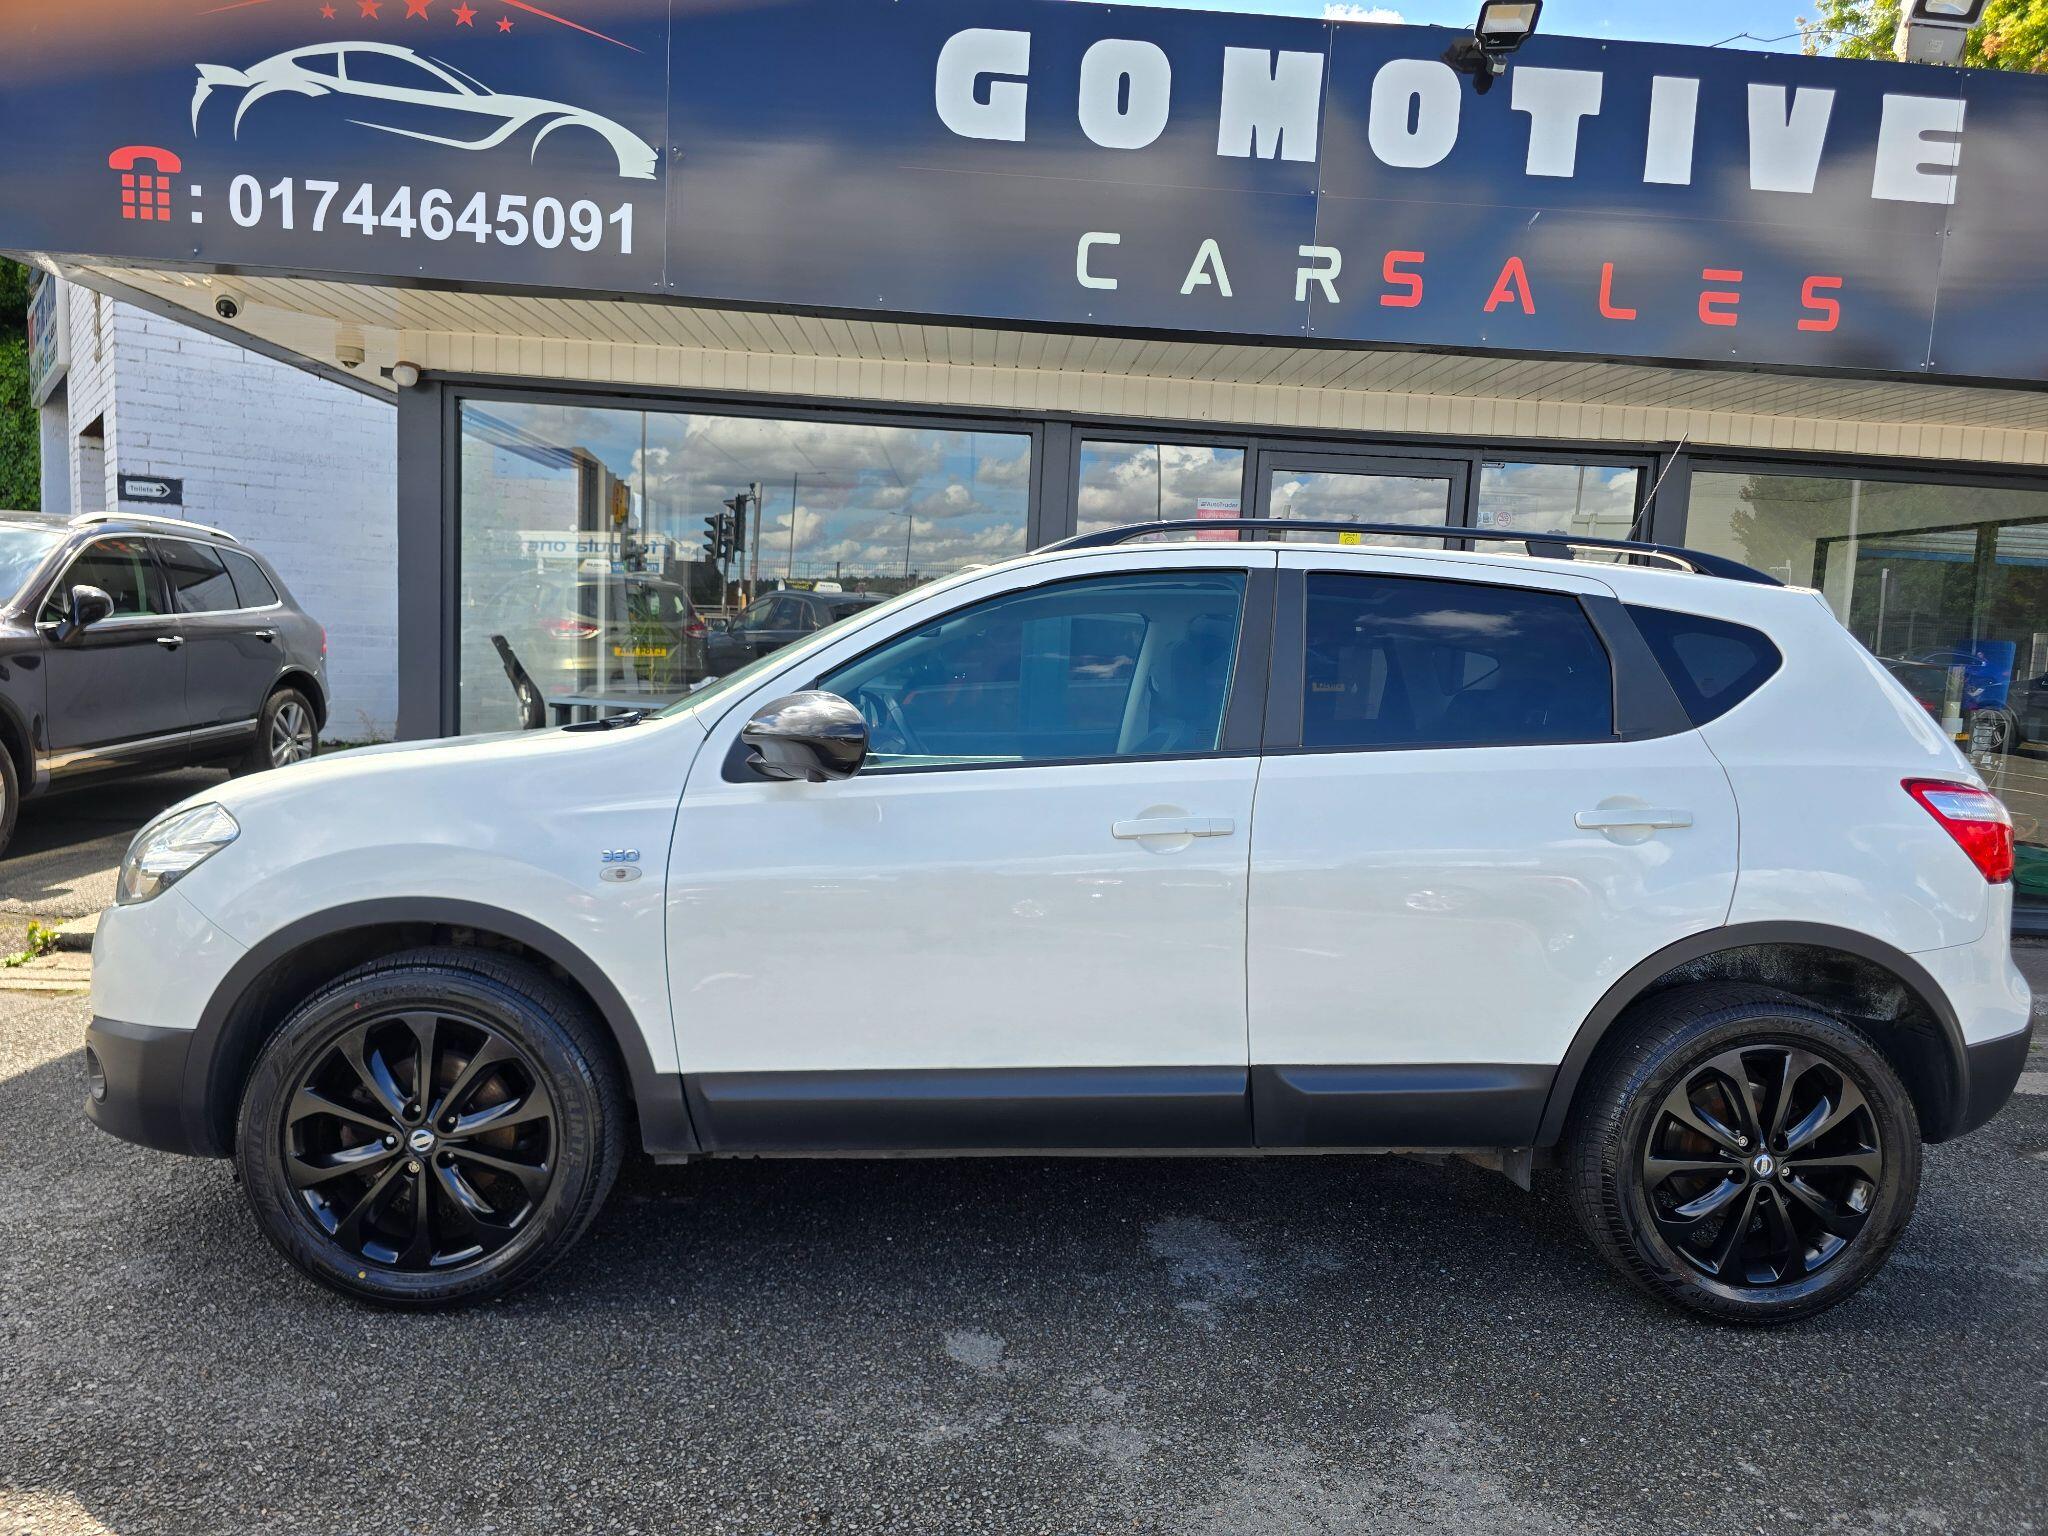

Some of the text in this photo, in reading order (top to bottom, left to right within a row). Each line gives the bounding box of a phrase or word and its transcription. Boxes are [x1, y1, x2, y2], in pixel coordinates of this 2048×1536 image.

[936, 28, 1966, 204] GOMOTIVE
[229, 174, 632, 254] 01744645091
[130, 485, 154, 493] Toilets
